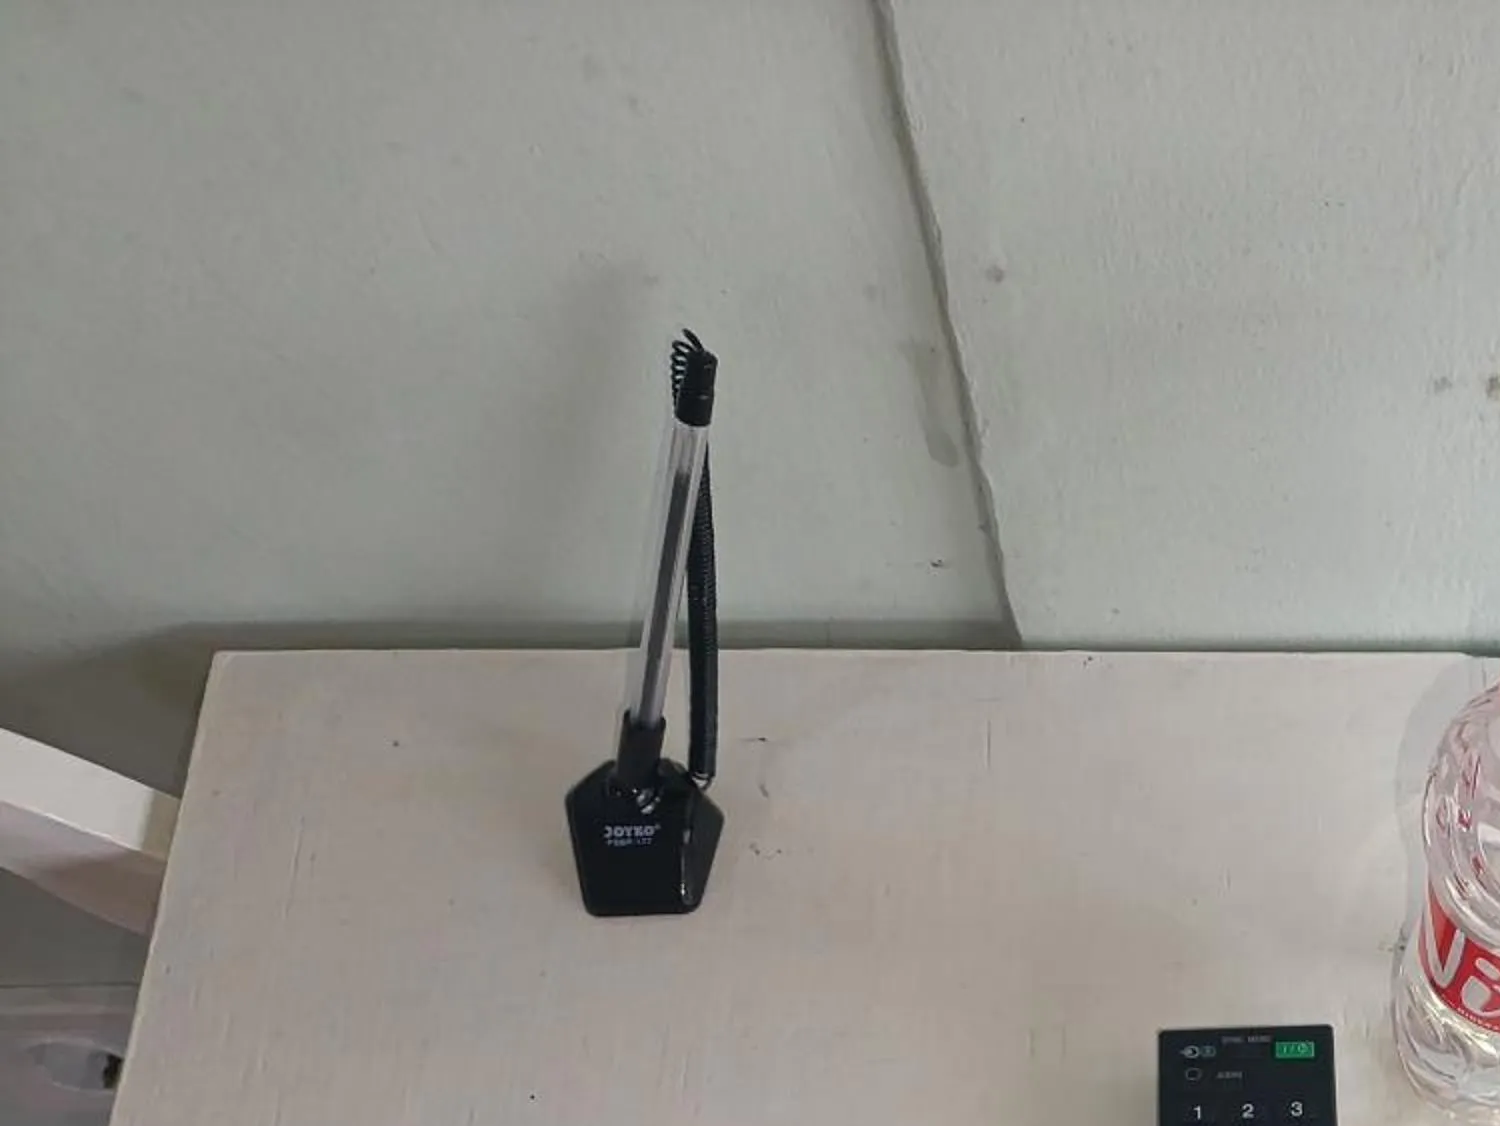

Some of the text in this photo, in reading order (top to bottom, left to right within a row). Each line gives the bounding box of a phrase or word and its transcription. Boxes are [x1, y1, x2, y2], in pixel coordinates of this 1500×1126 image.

[1194, 1101, 1303, 1120] 1 2 3
